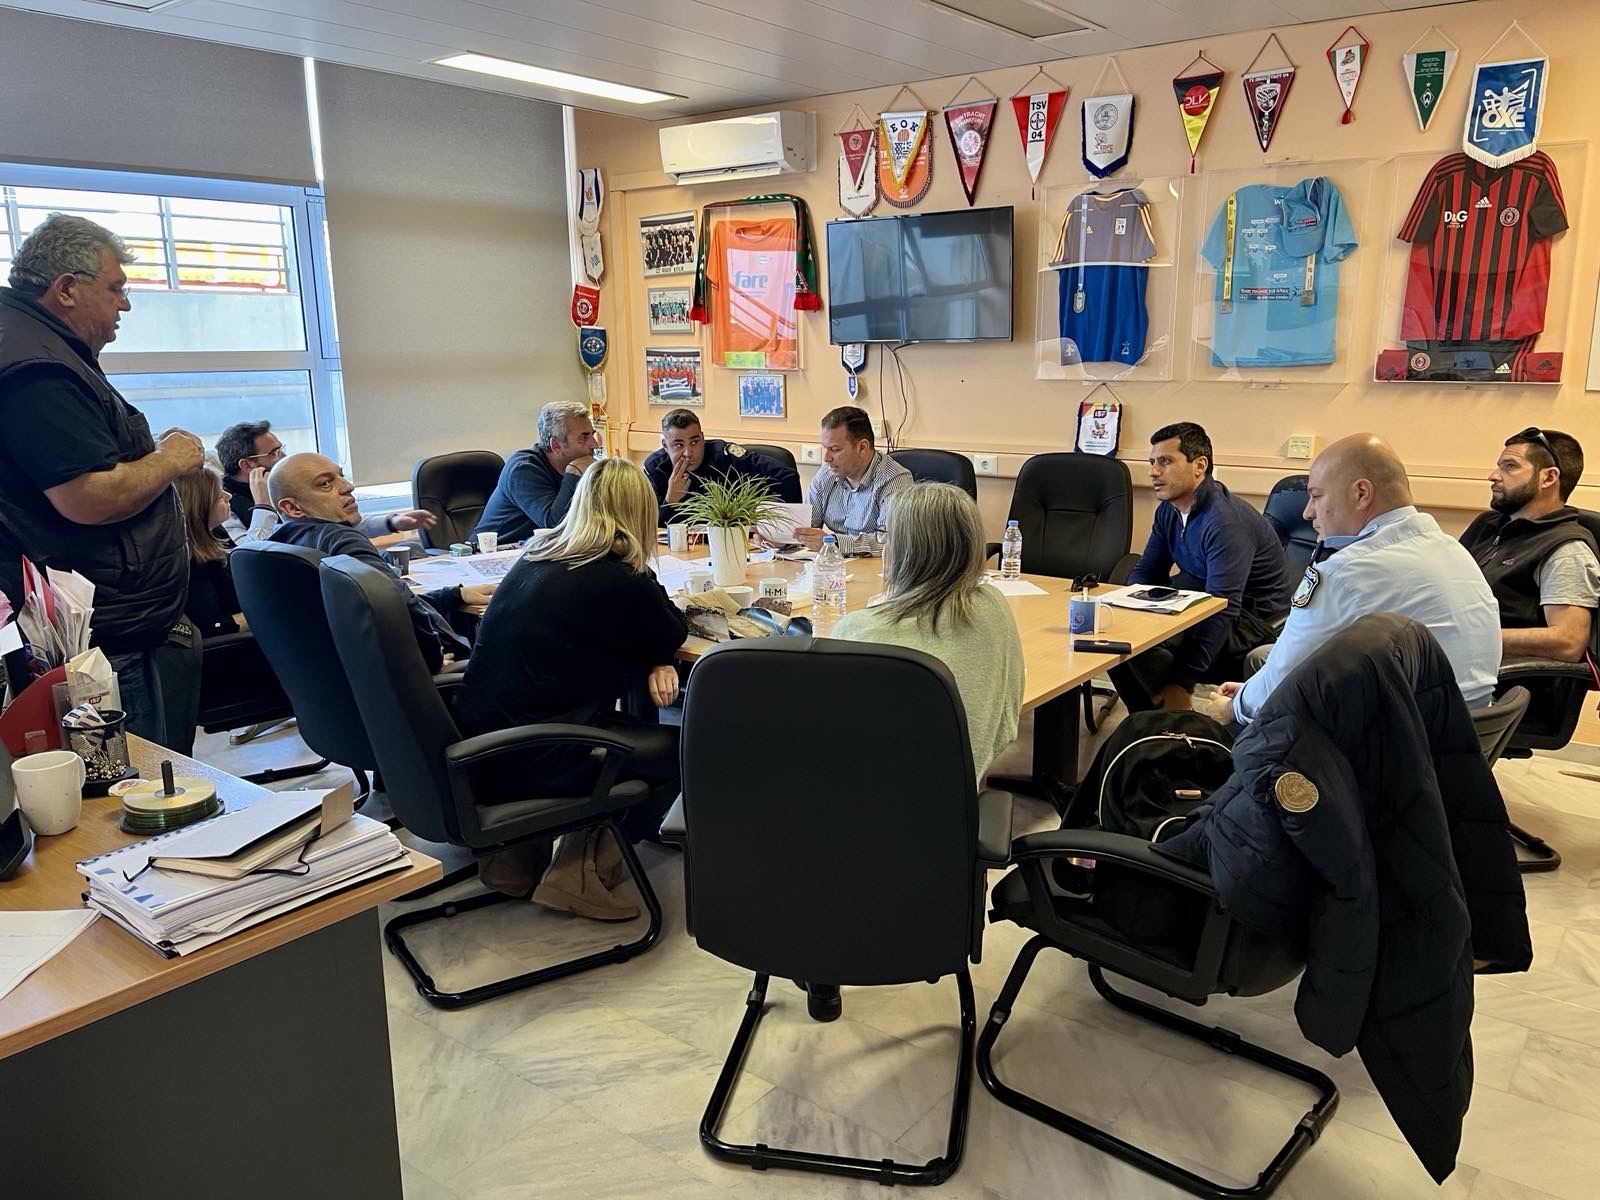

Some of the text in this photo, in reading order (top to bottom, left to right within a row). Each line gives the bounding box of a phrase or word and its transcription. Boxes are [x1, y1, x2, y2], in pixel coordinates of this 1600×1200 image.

[1031, 100, 1047, 111] TSV
[1031, 130, 1043, 139] 04
[1444, 210, 1469, 223] D&G
[735, 270, 769, 289] fare
